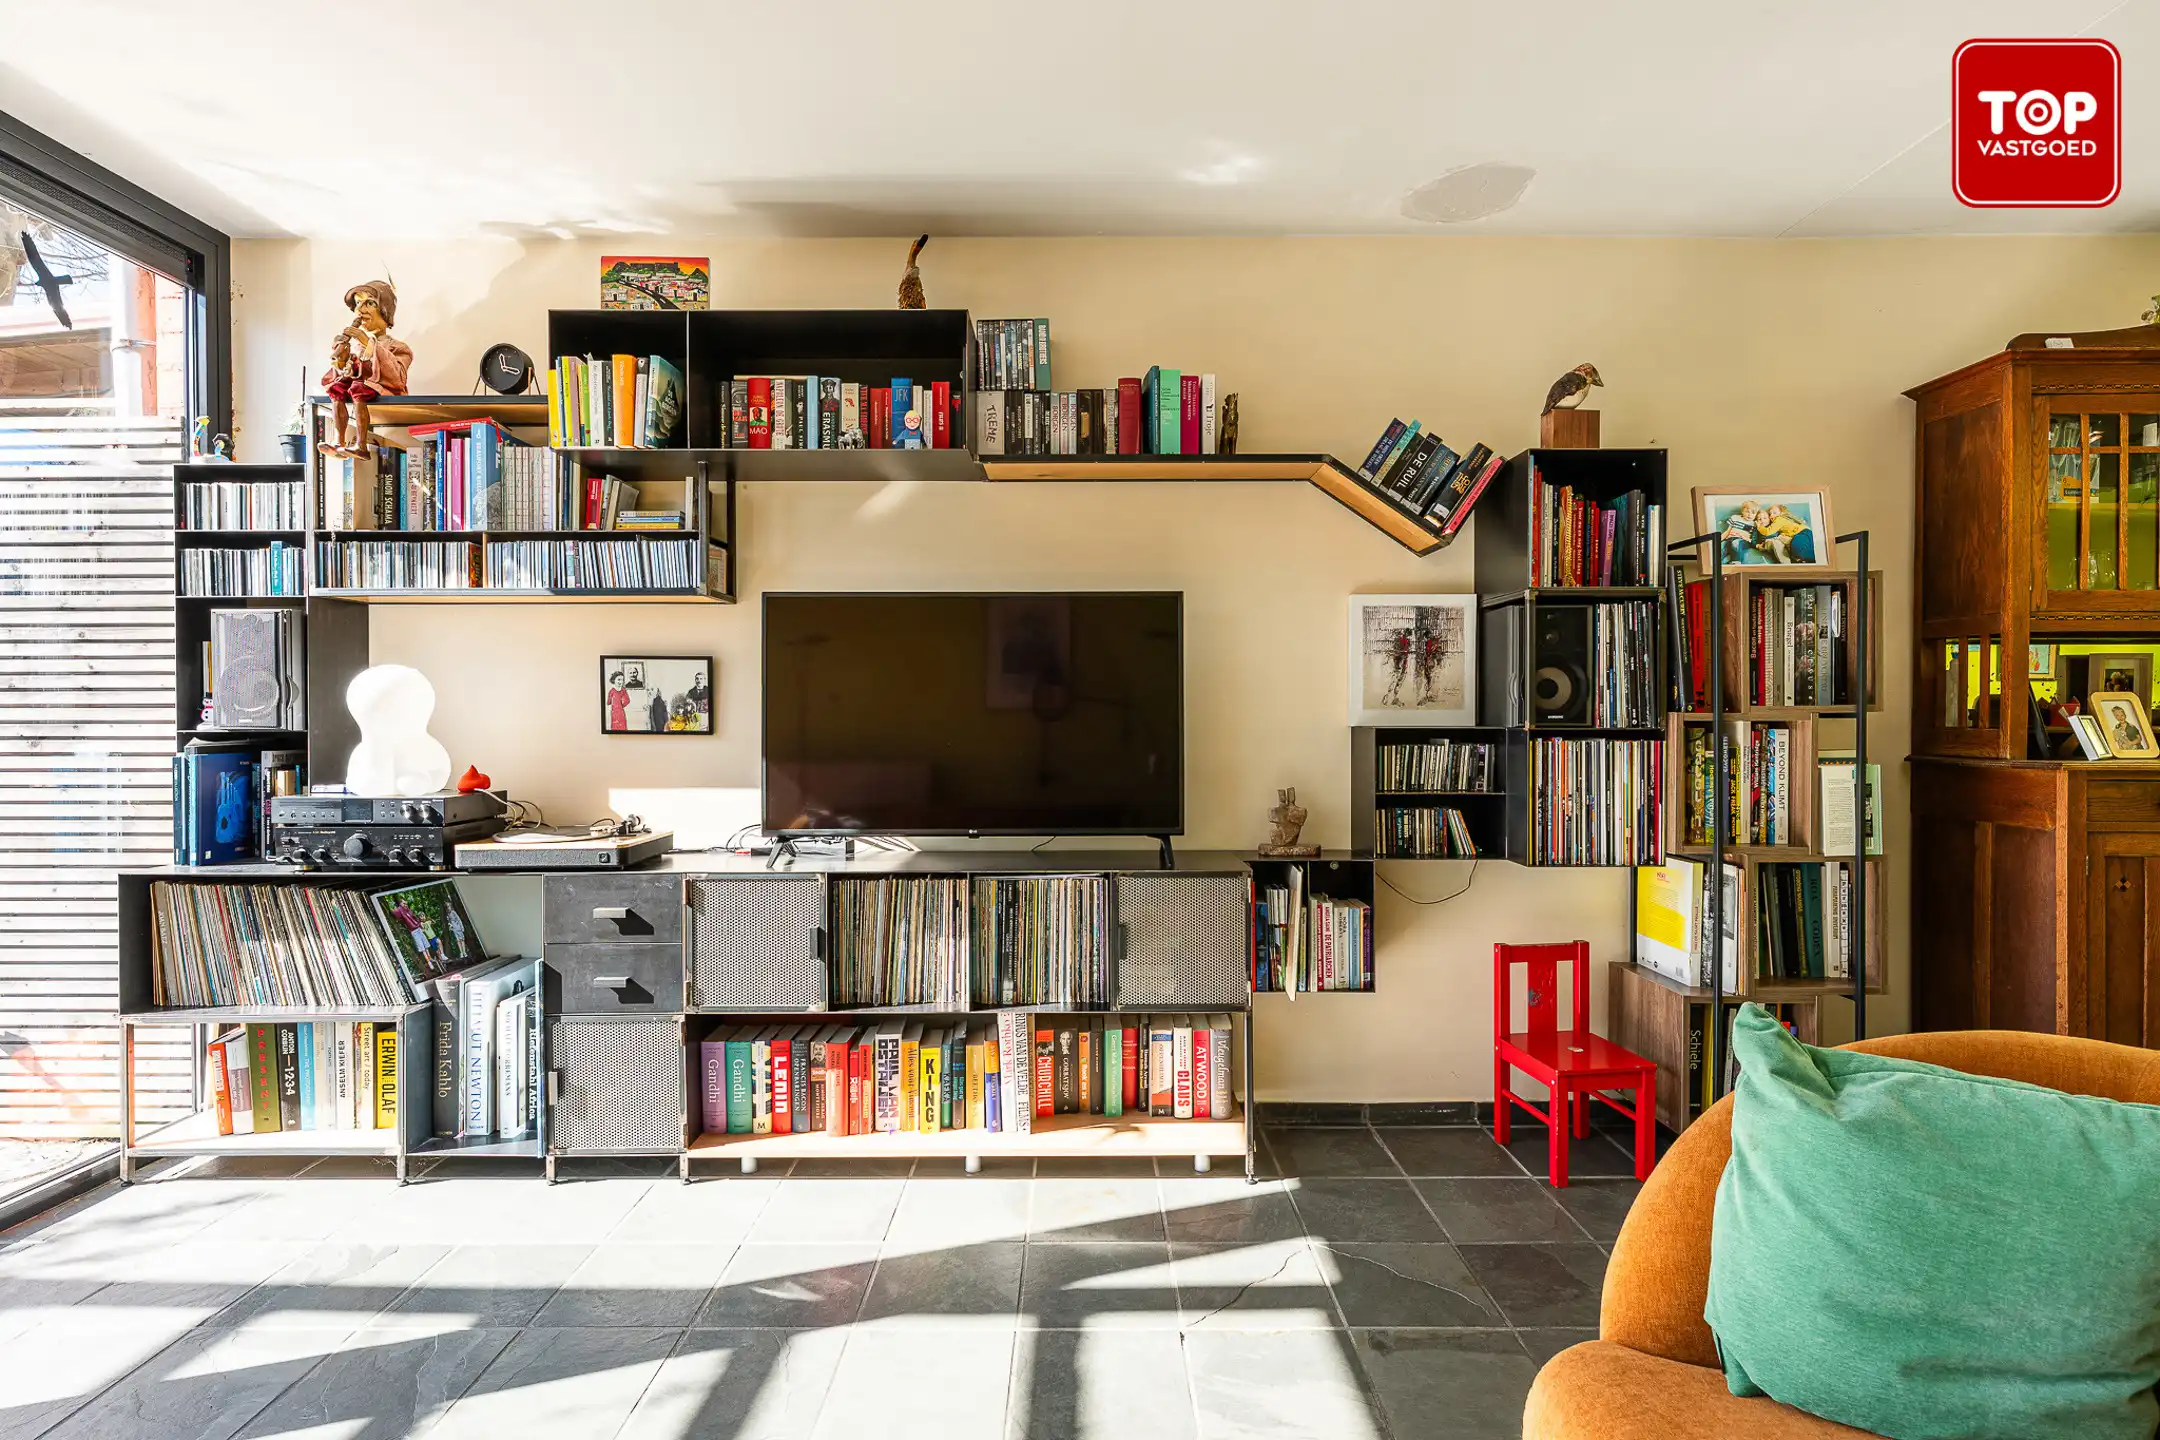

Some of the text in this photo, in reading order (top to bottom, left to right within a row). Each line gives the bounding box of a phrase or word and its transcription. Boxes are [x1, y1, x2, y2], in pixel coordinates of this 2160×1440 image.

[894, 389, 908, 401] JFK
[749, 427, 768, 435] MAO
[822, 412, 831, 449] ERASMU
[985, 404, 998, 444] TREME
[1208, 412, 1216, 430] Troje
[1396, 452, 1427, 489] DE RUIL
[384, 474, 393, 524] SIMON SCHAMA
[1786, 621, 1794, 648] Bruegel
[1753, 740, 1761, 767] Kentridge
[1778, 741, 1786, 811] BEYOND KLIMT
[1810, 878, 1820, 957] ROA CODEX
[1325, 941, 1333, 979] PATRIARCHEN
[363, 1026, 371, 1049] Street
[363, 1051, 371, 1062] art
[438, 1021, 453, 1098] Frida Kahlo
[470, 991, 483, 1121] HELMUT NEWTON
[1001, 1019, 1013, 1057] Rothko
[1690, 1029, 1702, 1070] Schiele
[337, 1040, 347, 1099] ANSELM KIEFER
[362, 1068, 371, 1090] today
[381, 1038, 396, 1114] ERWIN OLAF
[504, 1047, 512, 1097] BORREMANS
[528, 1027, 538, 1120] Riefenstahl Africa
[708, 1058, 720, 1103] Gandhi
[733, 1058, 744, 1103] Gandhi
[774, 1056, 787, 1113] LENIN
[889, 1038, 899, 1118] PAUL VAN
[907, 1047, 917, 1118] Alles voor Vincent
[926, 1058, 935, 1124] KING
[943, 1072, 951, 1103] KAFKA
[1015, 1013, 1029, 1127] RINUS VAN DE VELDE FILMS
[1038, 1056, 1052, 1110] CHURCHILL
[1062, 1057, 1070, 1099] GORBATSJOV
[1177, 1070, 1190, 1107] CLAUS
[1196, 1046, 1207, 1098] ATWOOD
